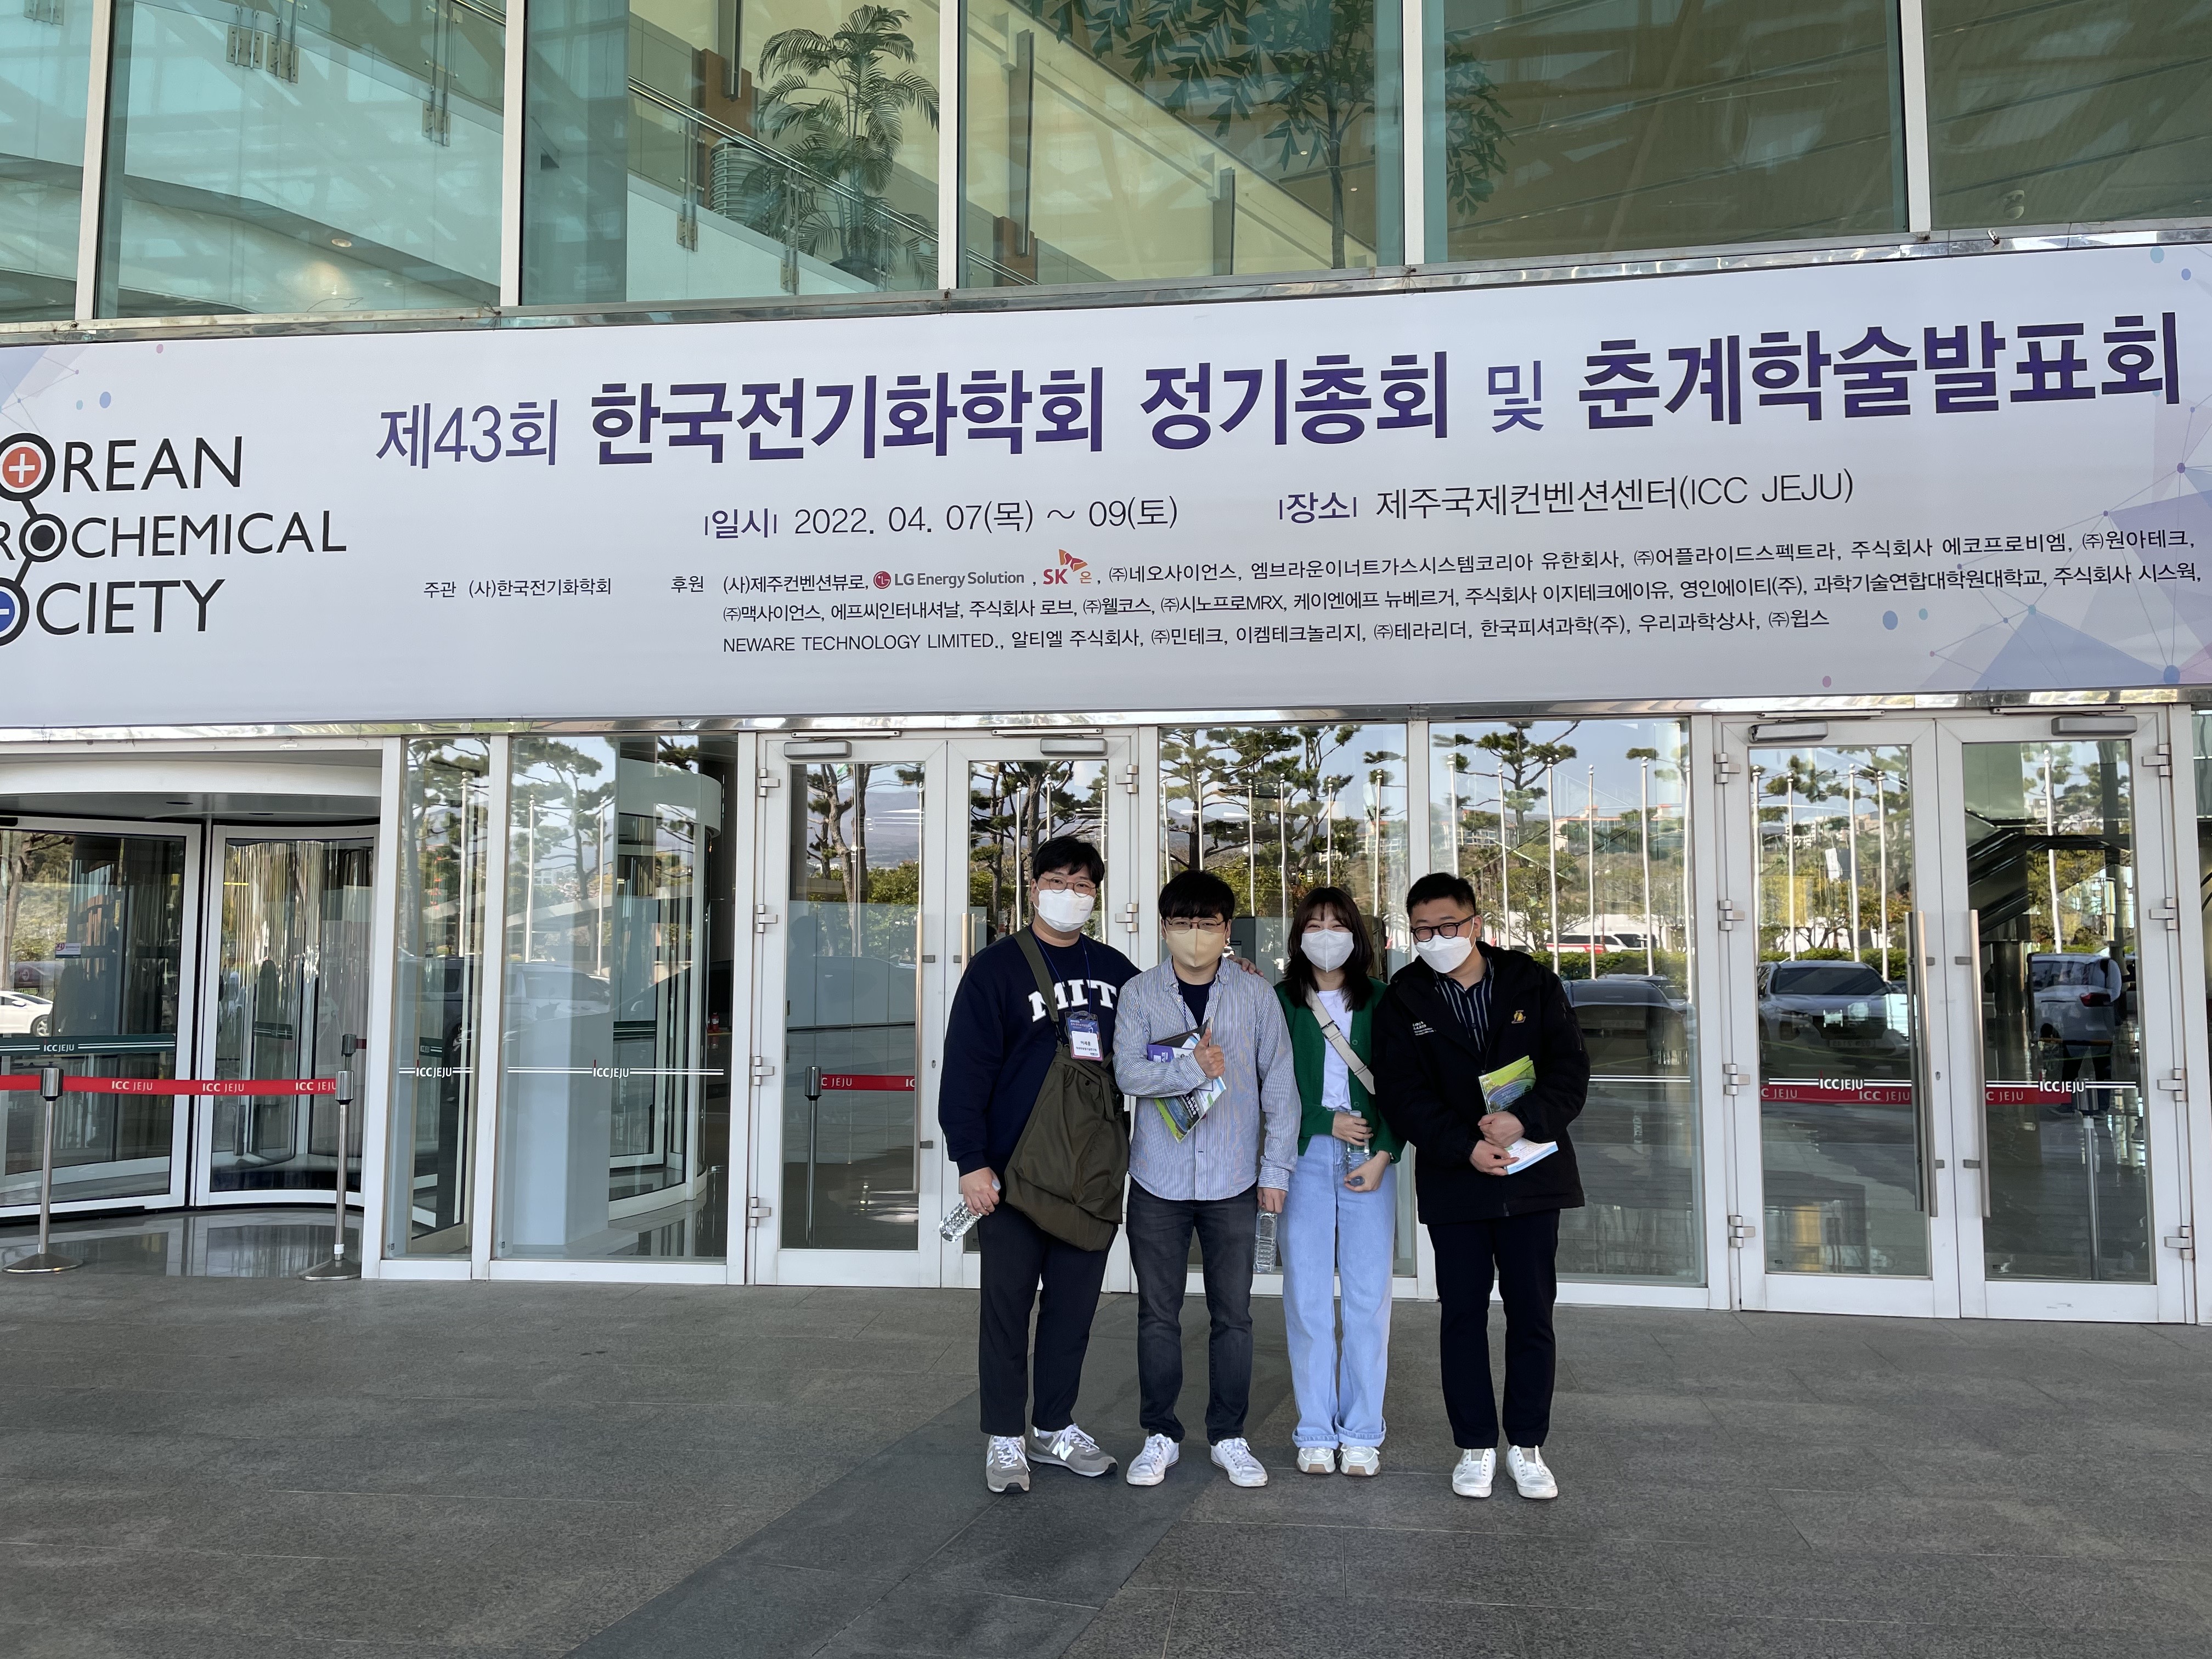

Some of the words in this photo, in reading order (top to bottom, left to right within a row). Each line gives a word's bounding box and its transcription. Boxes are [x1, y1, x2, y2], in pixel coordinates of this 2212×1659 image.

[375, 399, 558, 469] 제43회
[591, 366, 1103, 465] 한국전기화학회
[1140, 351, 1448, 450] 정기총회
[1488, 360, 1544, 433] 및
[1578, 312, 2180, 430] 춘계학술발표회
[1376, 475, 1748, 520] 제주국제컨벤션센터(ICC
[1761, 468, 1853, 504] JEJU)
[794, 507, 874, 534] 2022.
[888, 506, 932, 533] 04.
[946, 499, 1033, 534] 07(목)
[1089, 495, 1177, 530] 09(토)
[670, 575, 704, 594] 후원
[723, 574, 868, 595] (사)제주컨벤션뷰로,
[894, 573, 915, 586] LG
[917, 572, 966, 589] Energy
[967, 571, 1025, 584] Solution
[1042, 568, 1069, 585] SK
[1251, 553, 1533, 580] 엠브라운이너트가스시스템코리아
[1541, 550, 1624, 571] 유한회사,
[1850, 538, 1933, 559] 주식회사
[1942, 533, 2072, 556] 에코프로비엠,
[423, 581, 457, 599] 주관
[469, 578, 611, 599] (사)한국전기화학회
[831, 601, 964, 620] 에프씨인터내셔날,
[969, 599, 1036, 618] 주식회사
[1040, 600, 1077, 617] 로브,
[1294, 591, 1380, 611] 케이엔에프
[1384, 588, 1459, 608] 뉴베르거,
[1465, 585, 1538, 606] 주식회사
[1543, 581, 1674, 603] 이지테크에이유,
[1680, 575, 1807, 599] 영인에이티(주),
[1814, 568, 2047, 594] 과학기술연합대학원대학교,
[2053, 565, 2132, 586] 주식회사
[2138, 562, 2201, 583] 시스웍,
[724, 637, 795, 652] NEWARE
[801, 634, 921, 651] TECHNOLOGY
[928, 633, 1004, 650] LIMITED.,
[1012, 630, 1063, 648] 알티엘
[1069, 628, 1144, 647] 주식회사,
[1236, 623, 1366, 644] 이켐테크놀리지,
[1480, 614, 1630, 637] 한국피셔과학(주),
[1638, 611, 1760, 633] 우리과학상사,
[1028, 979, 1117, 1023] MIT
[111, 1081, 129, 1090] ICC
[132, 1082, 153, 1091] JEJU
[202, 1083, 221, 1092] ICC
[224, 1083, 245, 1093] JEJU
[295, 1082, 314, 1091] ICC
[318, 1082, 336, 1091] JEJU
[831, 1077, 853, 1087] JEJU
[1774, 1088, 1798, 1099] JEJU
[1859, 1091, 1881, 1101] ICC
[1886, 1091, 1910, 1102] JEJU
[1999, 1091, 2024, 1102] JEJU
